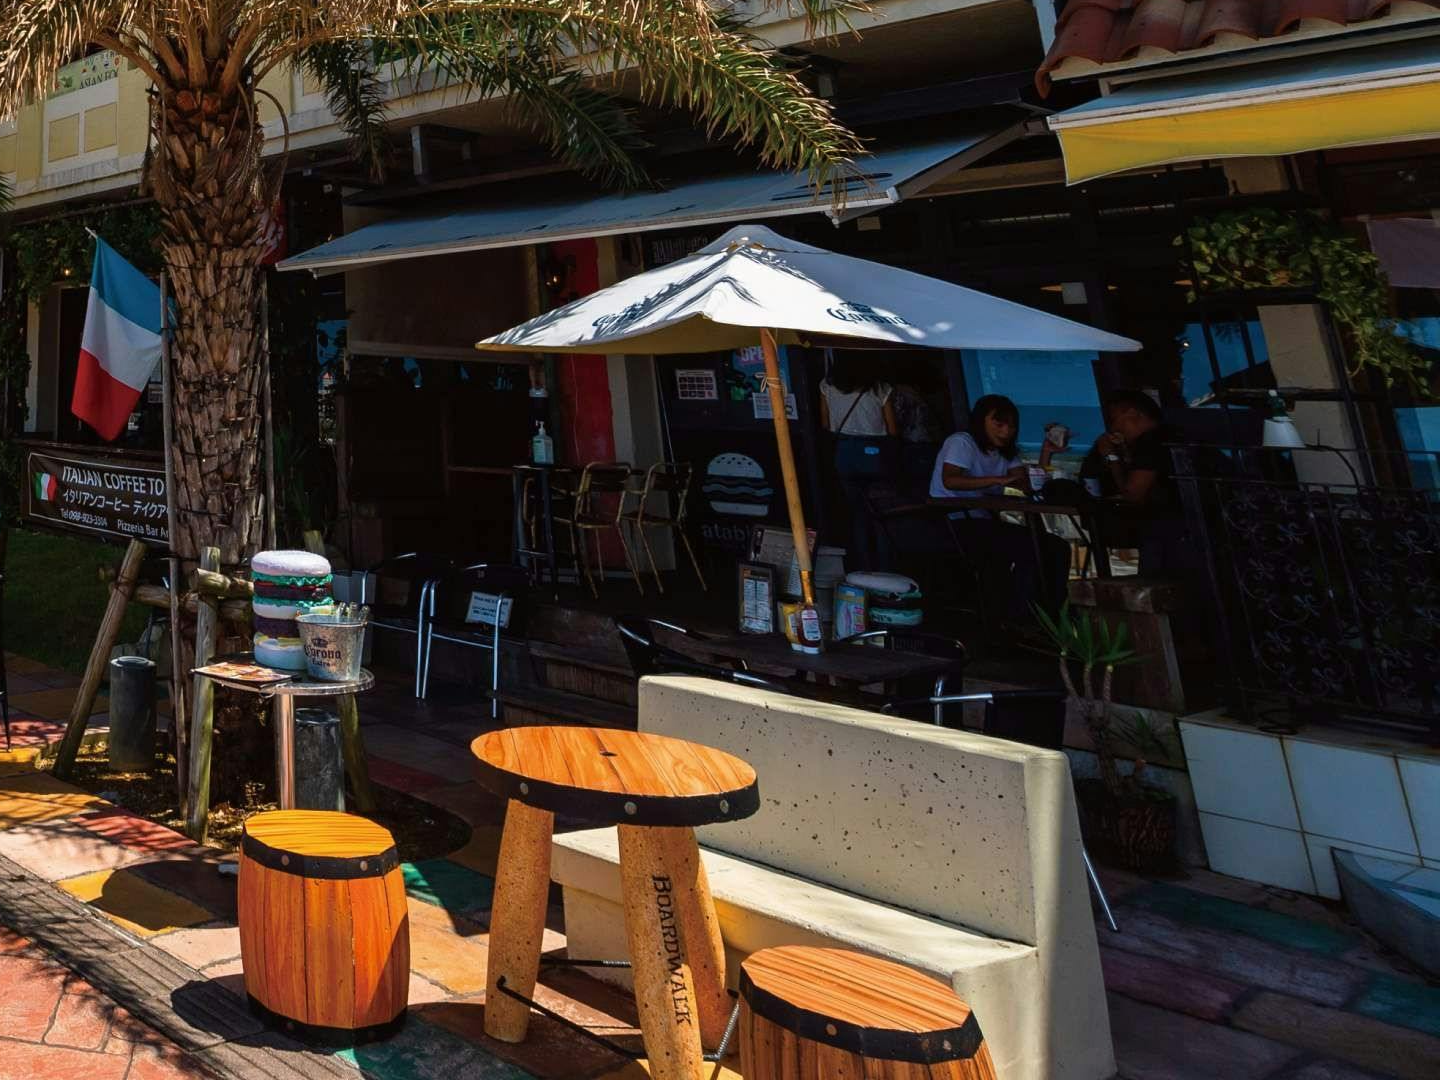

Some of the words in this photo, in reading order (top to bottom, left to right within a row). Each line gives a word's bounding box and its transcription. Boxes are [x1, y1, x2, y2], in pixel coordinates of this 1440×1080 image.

[62, 466, 102, 488] ITALIAN
[103, 472, 146, 494] COFFEE
[147, 477, 164, 496] TO
[63, 489, 130, 512] イタリアンコーヒー
[117, 519, 144, 534] Pizzeria
[145, 523, 158, 536] Bar
[304, 643, 342, 660] Corona
[652, 874, 692, 1026] BOARDWALK
